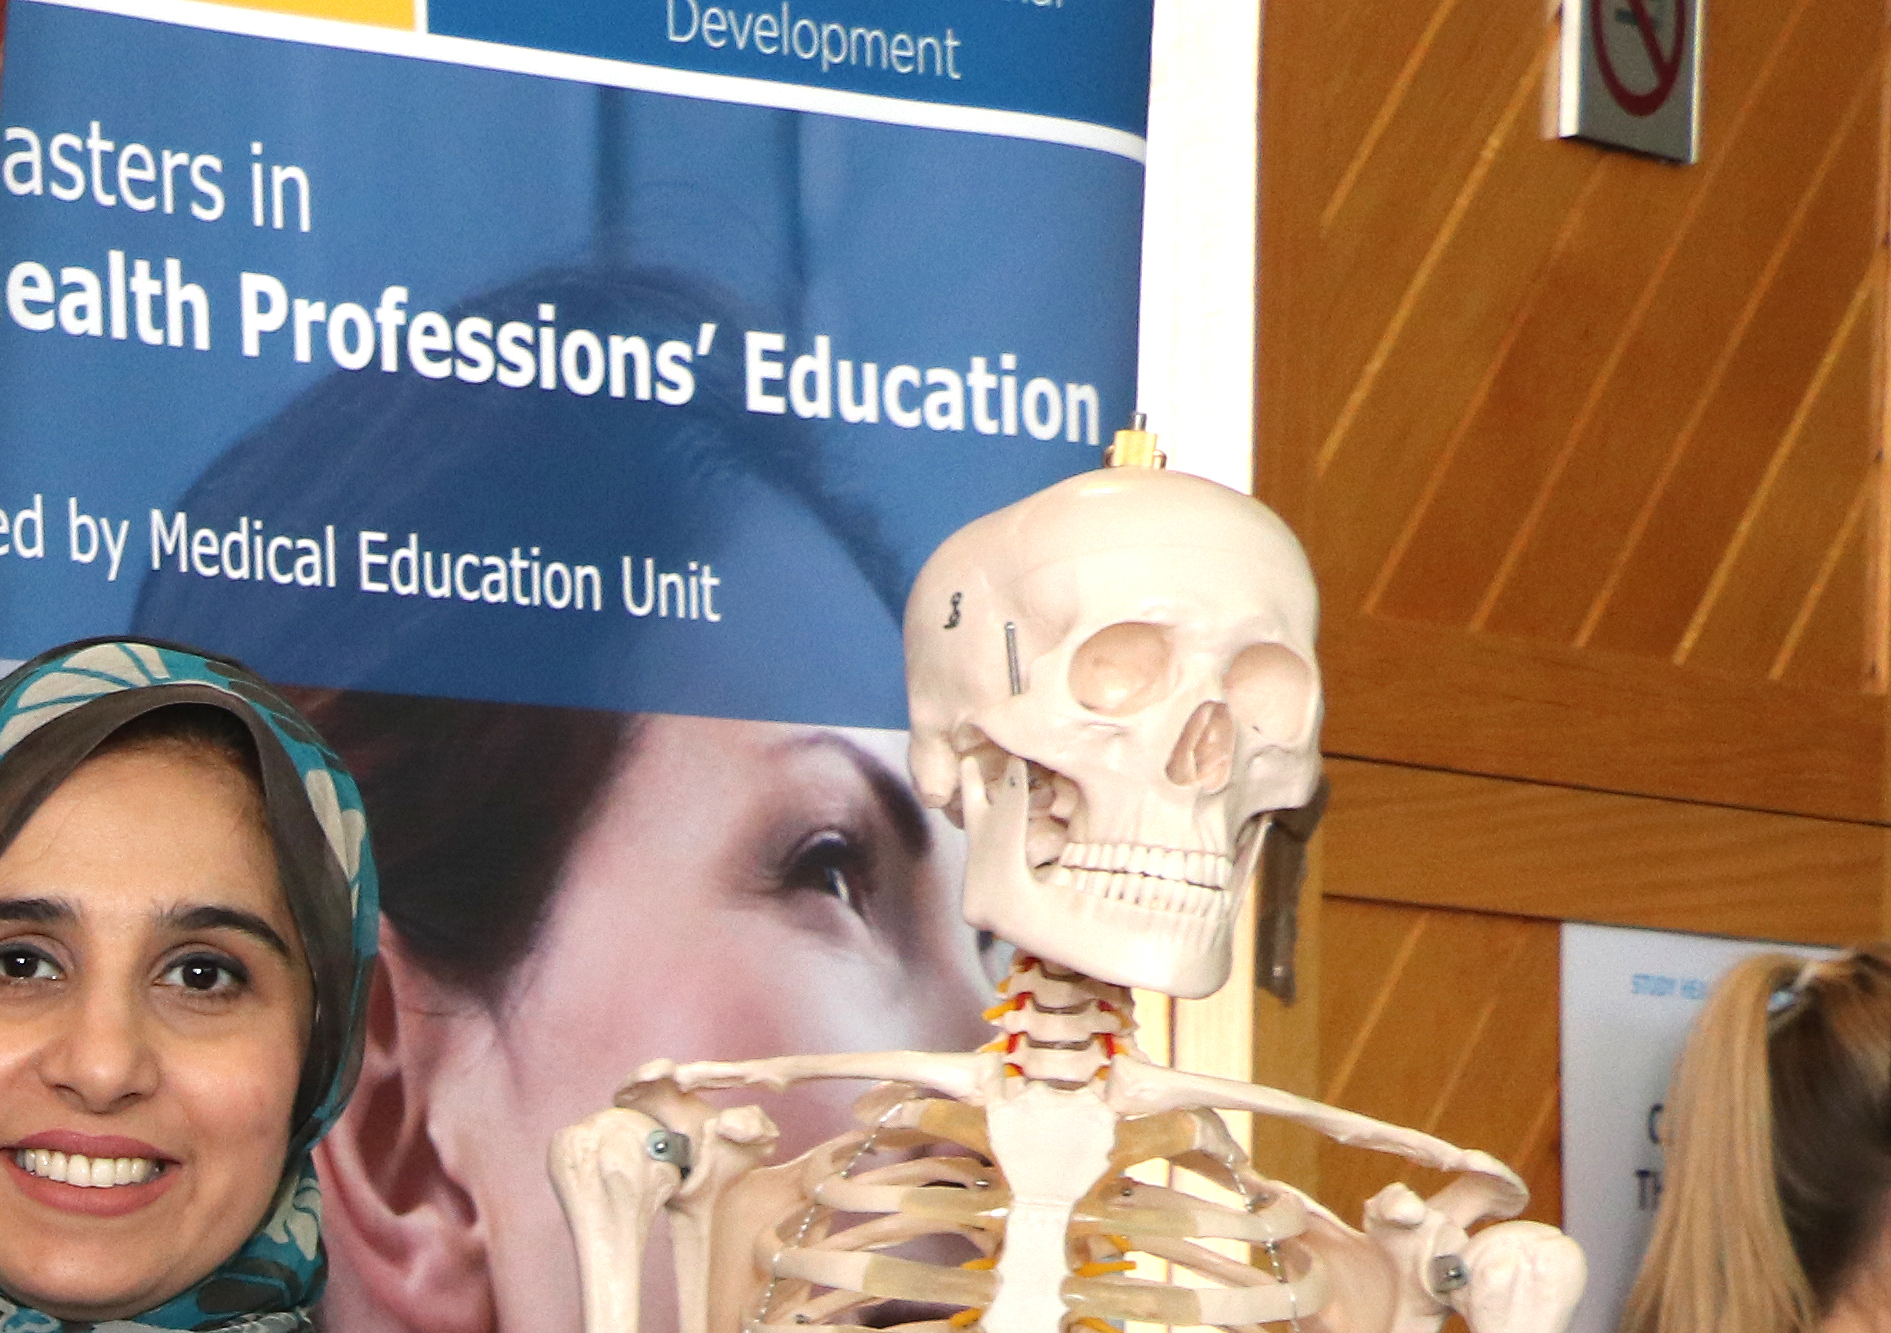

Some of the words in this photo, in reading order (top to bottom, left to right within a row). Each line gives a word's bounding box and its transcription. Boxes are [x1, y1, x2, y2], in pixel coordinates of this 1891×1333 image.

[665, 0, 963, 81] Development
[2, 121, 225, 227] asters
[252, 142, 312, 232] in
[239, 271, 716, 405] Professions’
[745, 332, 1100, 447] Education
[68, 496, 130, 582] by
[150, 509, 337, 590] Medical
[359, 531, 603, 613] Education
[622, 557, 721, 623] Unit
